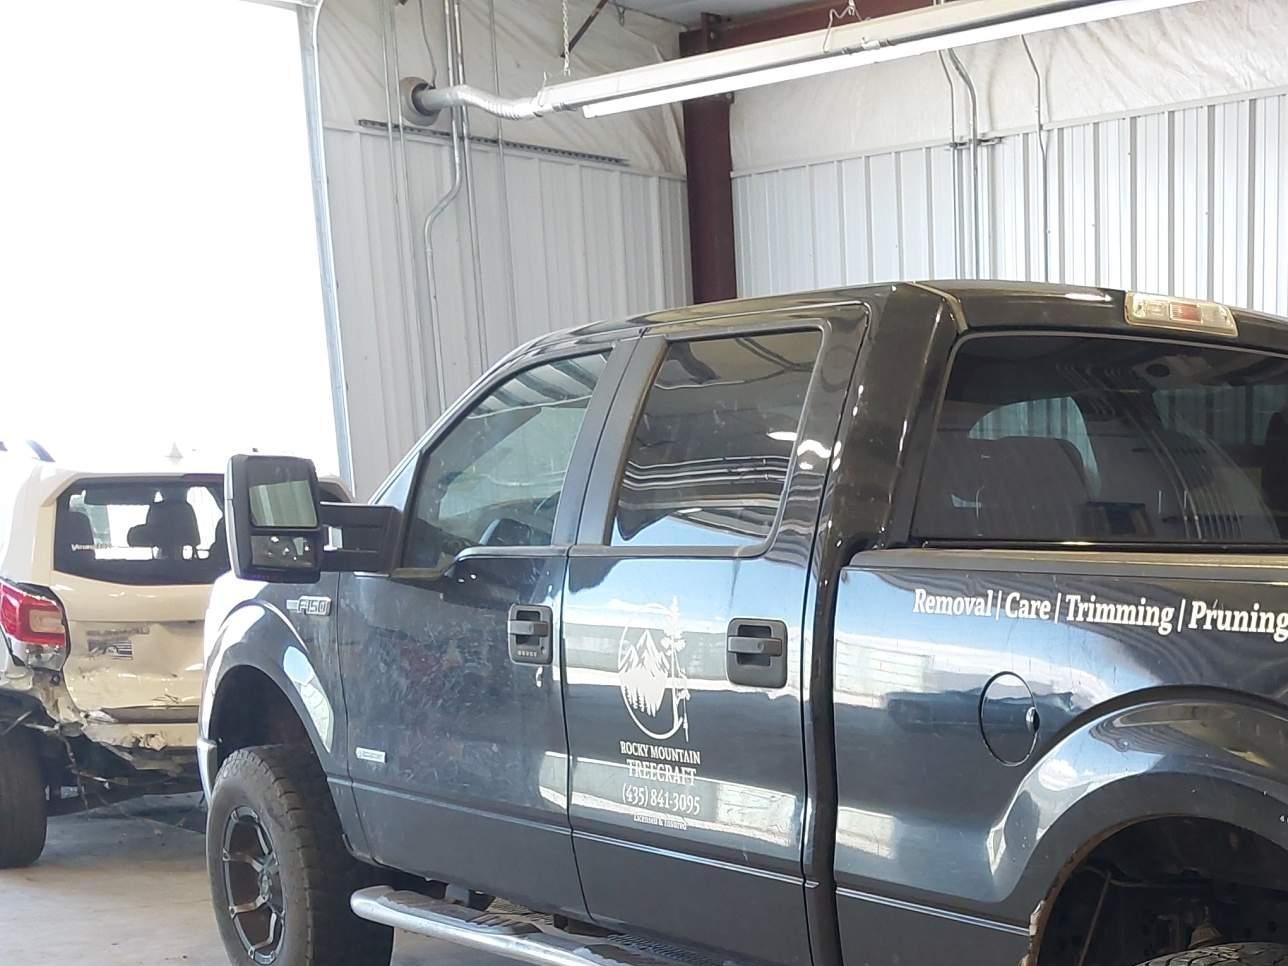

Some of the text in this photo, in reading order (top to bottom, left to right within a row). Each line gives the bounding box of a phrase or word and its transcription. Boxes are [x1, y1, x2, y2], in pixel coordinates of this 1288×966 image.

[912, 588, 993, 617] Removal
[1004, 592, 1051, 620] Care
[1065, 594, 1175, 635] Trimming
[620, 740, 701, 765] ROCKY MOUNTAIN
[625, 759, 697, 786] TREECRAFT
[622, 783, 701, 816] (435) 841-3095
